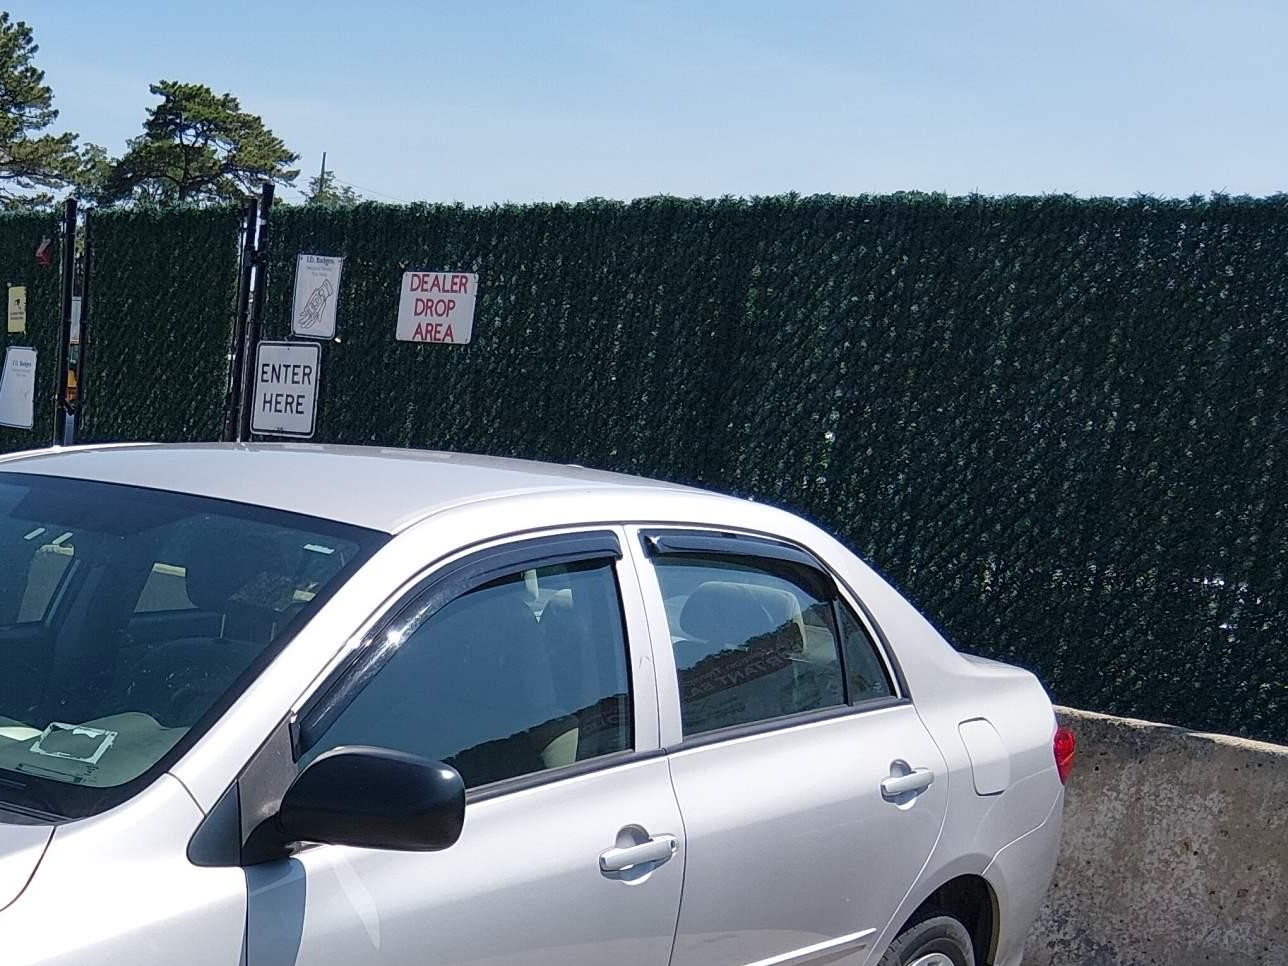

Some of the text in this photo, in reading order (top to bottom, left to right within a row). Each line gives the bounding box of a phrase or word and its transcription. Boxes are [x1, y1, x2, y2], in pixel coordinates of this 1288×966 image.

[410, 273, 469, 294] DEALER
[414, 298, 456, 318] DROP
[412, 322, 455, 342] AREA
[261, 363, 312, 385] ENTER
[262, 393, 306, 414] HERE
